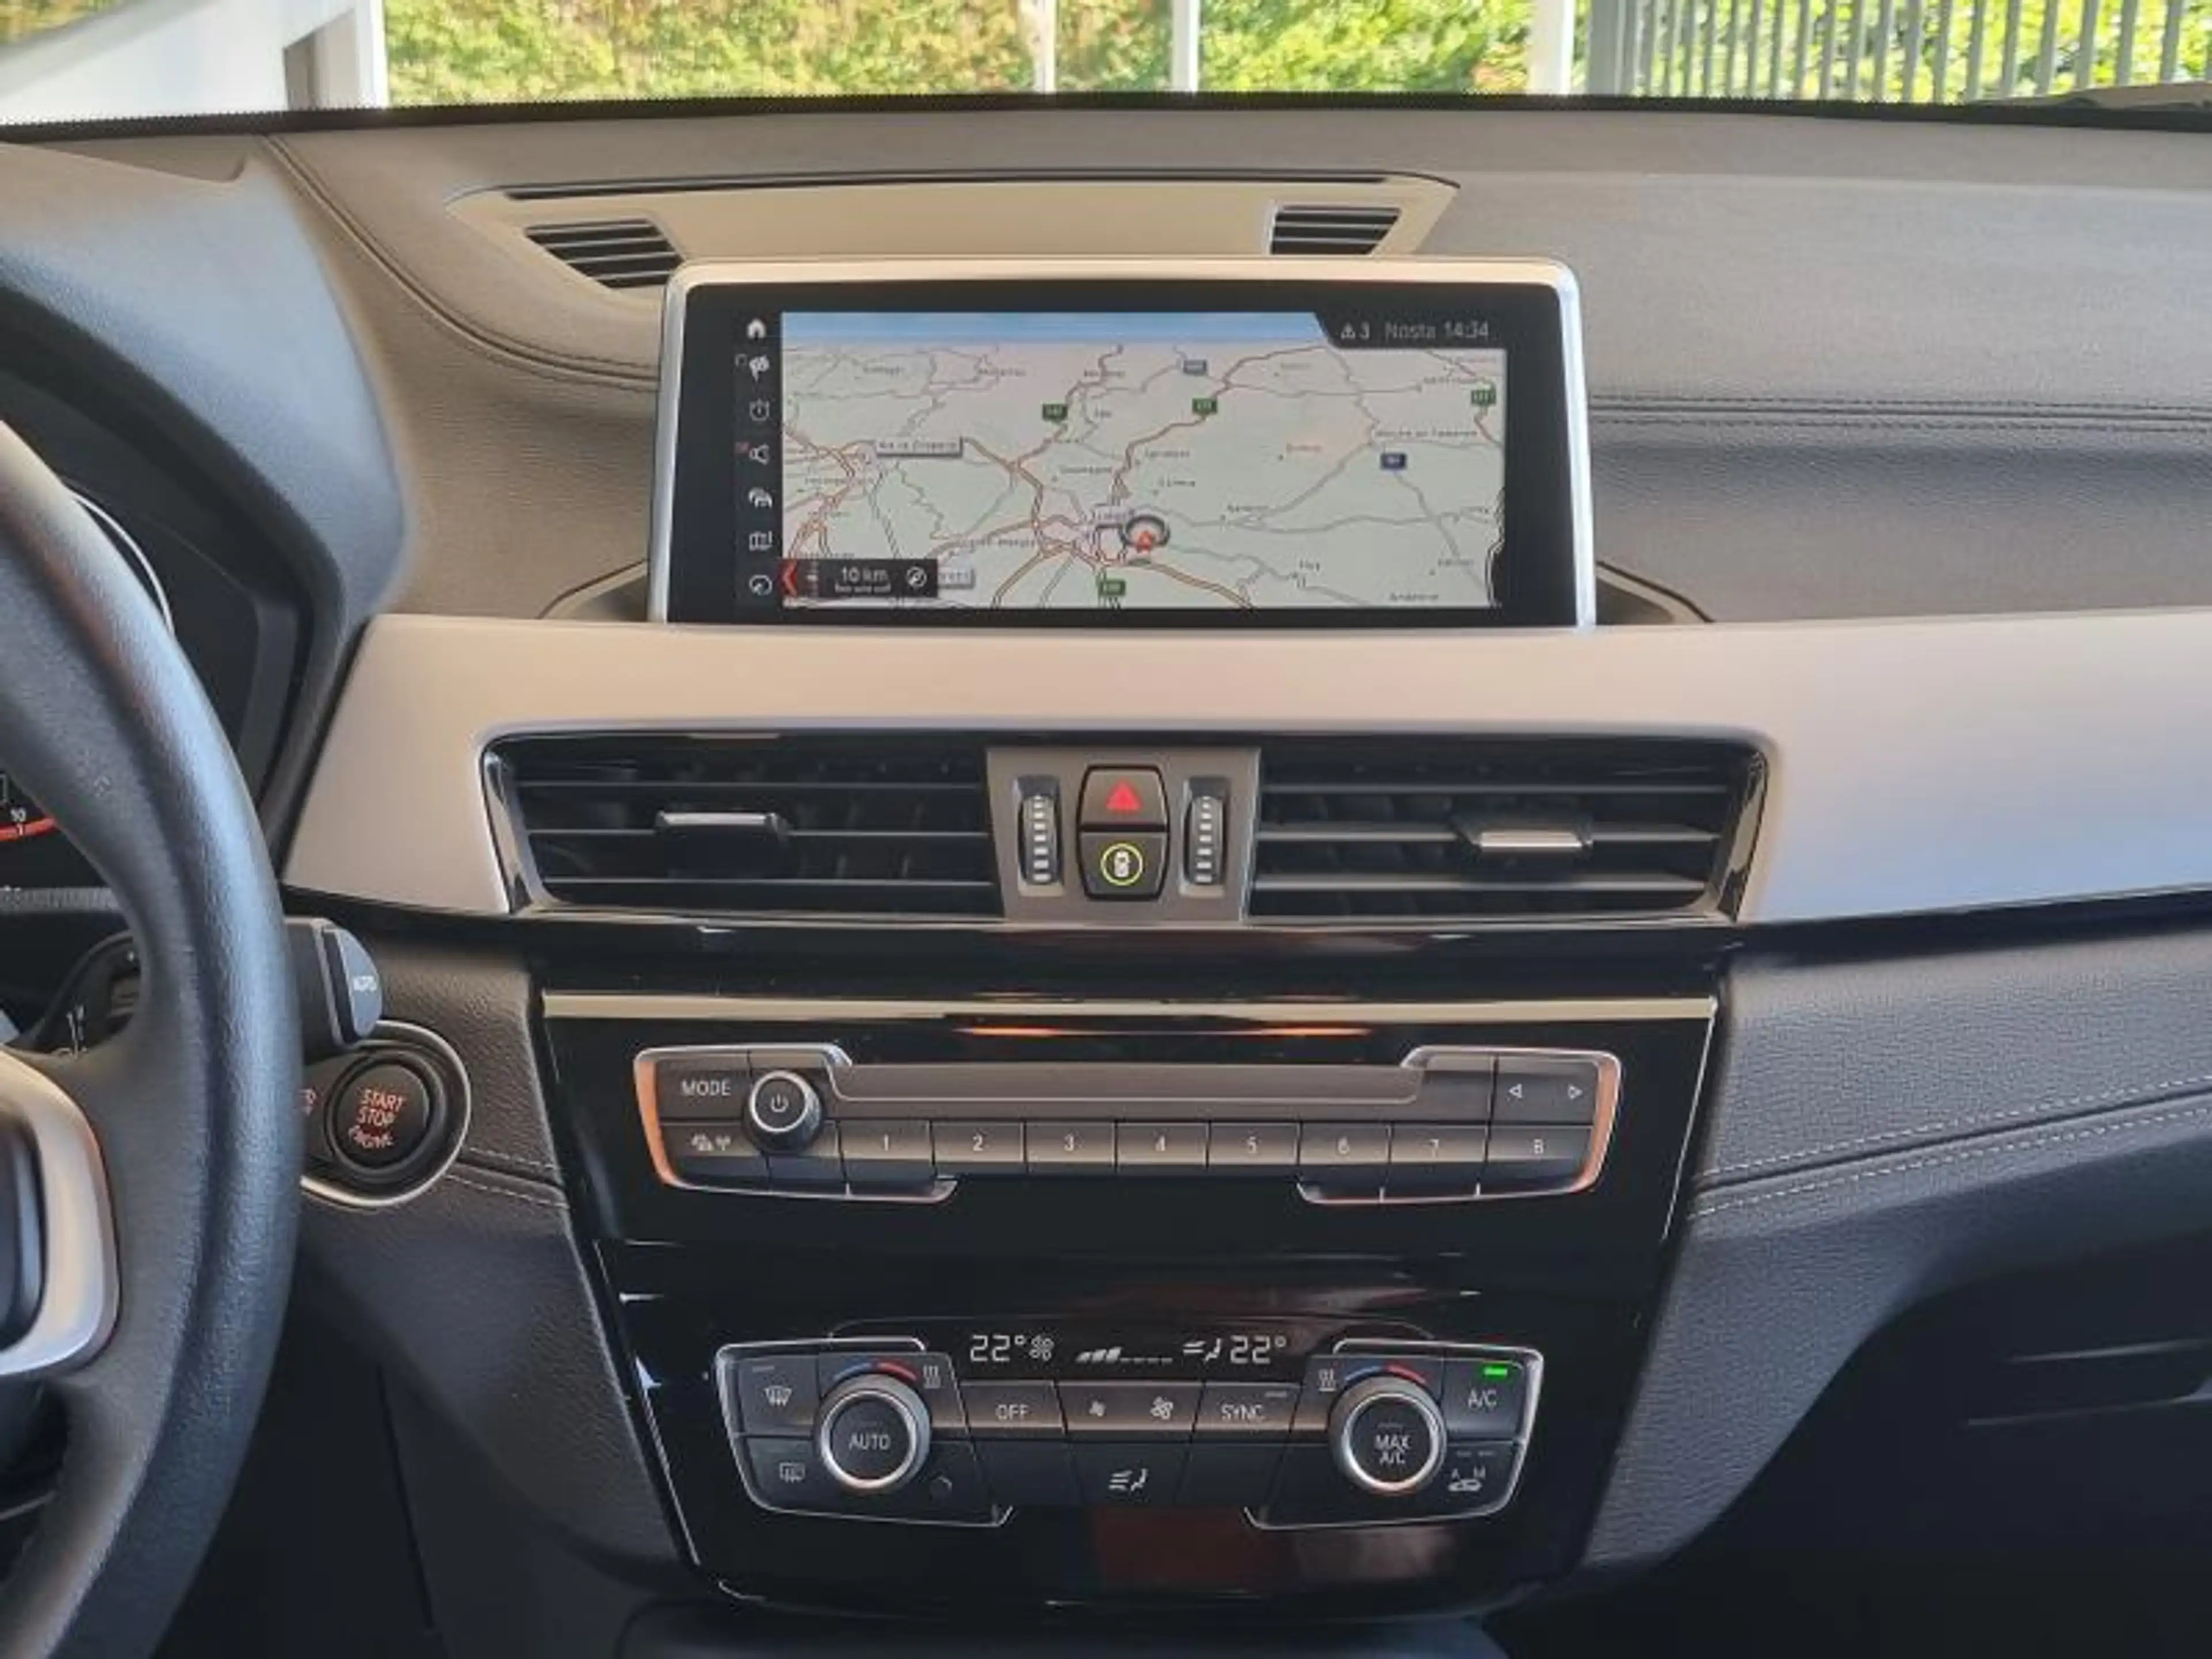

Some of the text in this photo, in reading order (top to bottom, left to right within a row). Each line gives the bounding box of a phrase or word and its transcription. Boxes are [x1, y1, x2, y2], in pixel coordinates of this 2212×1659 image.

[1359, 321, 1370, 340] 3
[1445, 320, 1489, 340] 14:34
[841, 566, 861, 583] 10
[681, 1079, 731, 1096] MODE
[882, 1134, 1544, 1156] 1 2 3 4 5 6 7 8
[1468, 1388, 1497, 1408] A/C
[996, 1403, 1029, 1421] OFF
[1221, 1403, 1265, 1421] SYNC
[849, 1432, 891, 1450] AUTO
[1374, 1434, 1410, 1451] MAX
